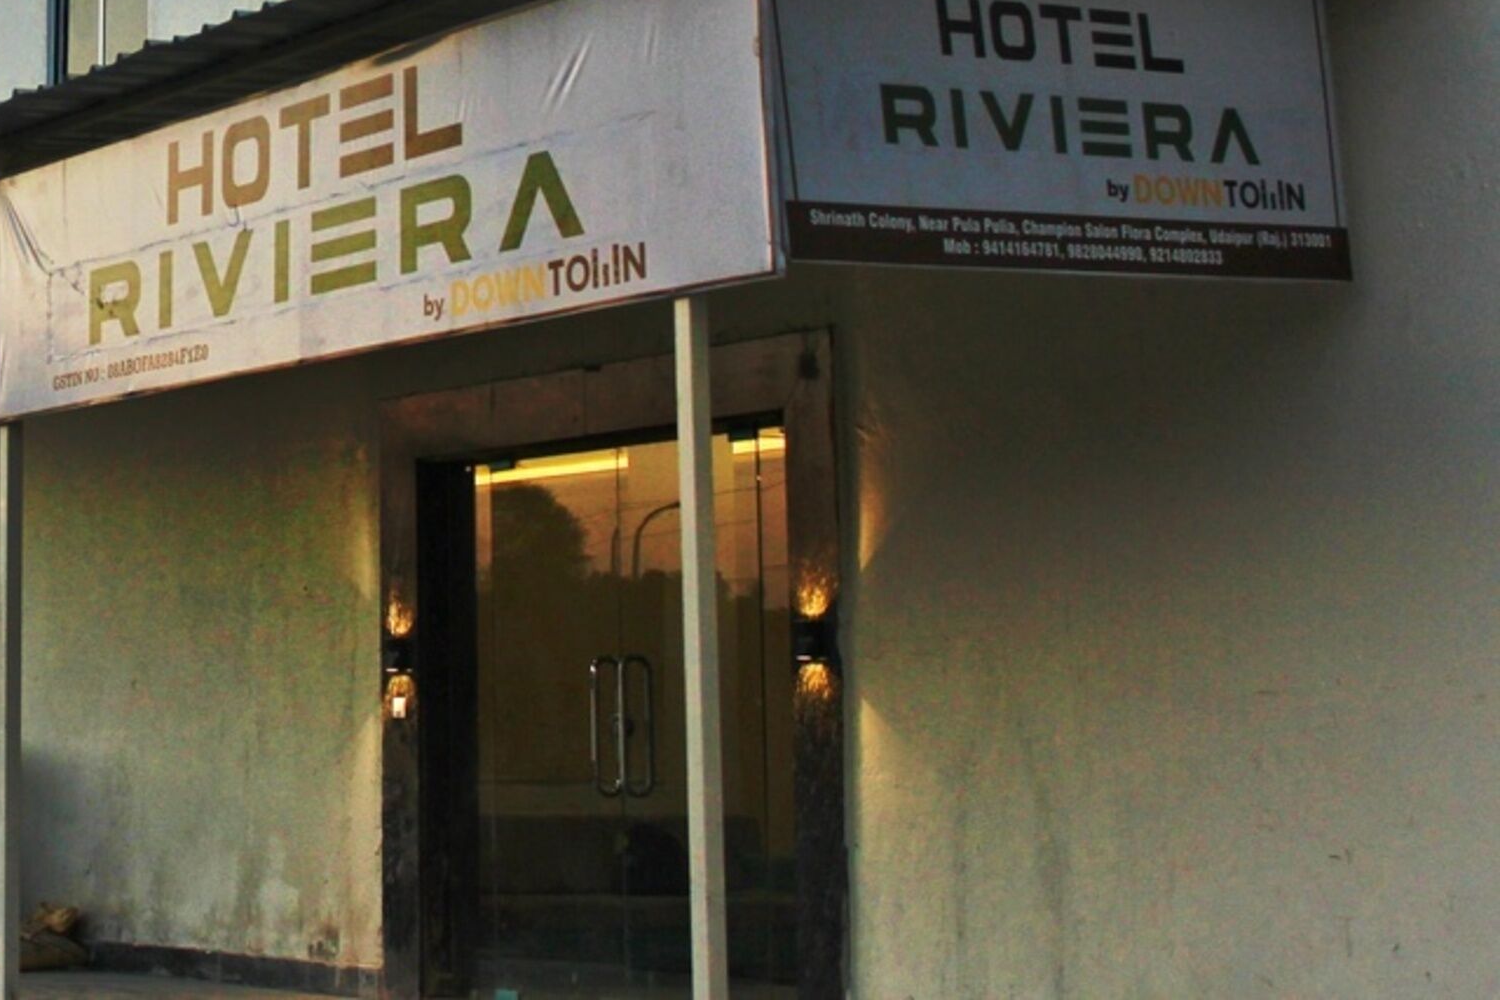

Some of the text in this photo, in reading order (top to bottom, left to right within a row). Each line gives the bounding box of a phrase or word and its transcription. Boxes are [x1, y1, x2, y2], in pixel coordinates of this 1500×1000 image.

[880, 83, 1260, 166] RIVIERA
[166, 66, 463, 226] HOTEL
[1106, 178, 1129, 203] by
[809, 208, 866, 227] Shrinath
[868, 212, 917, 233] Colony,
[918, 214, 948, 232] Near
[88, 150, 584, 345] RIVIERA
[943, 238, 972, 255] Mob
[423, 294, 444, 321] by
[52, 370, 83, 392] GSTIN
